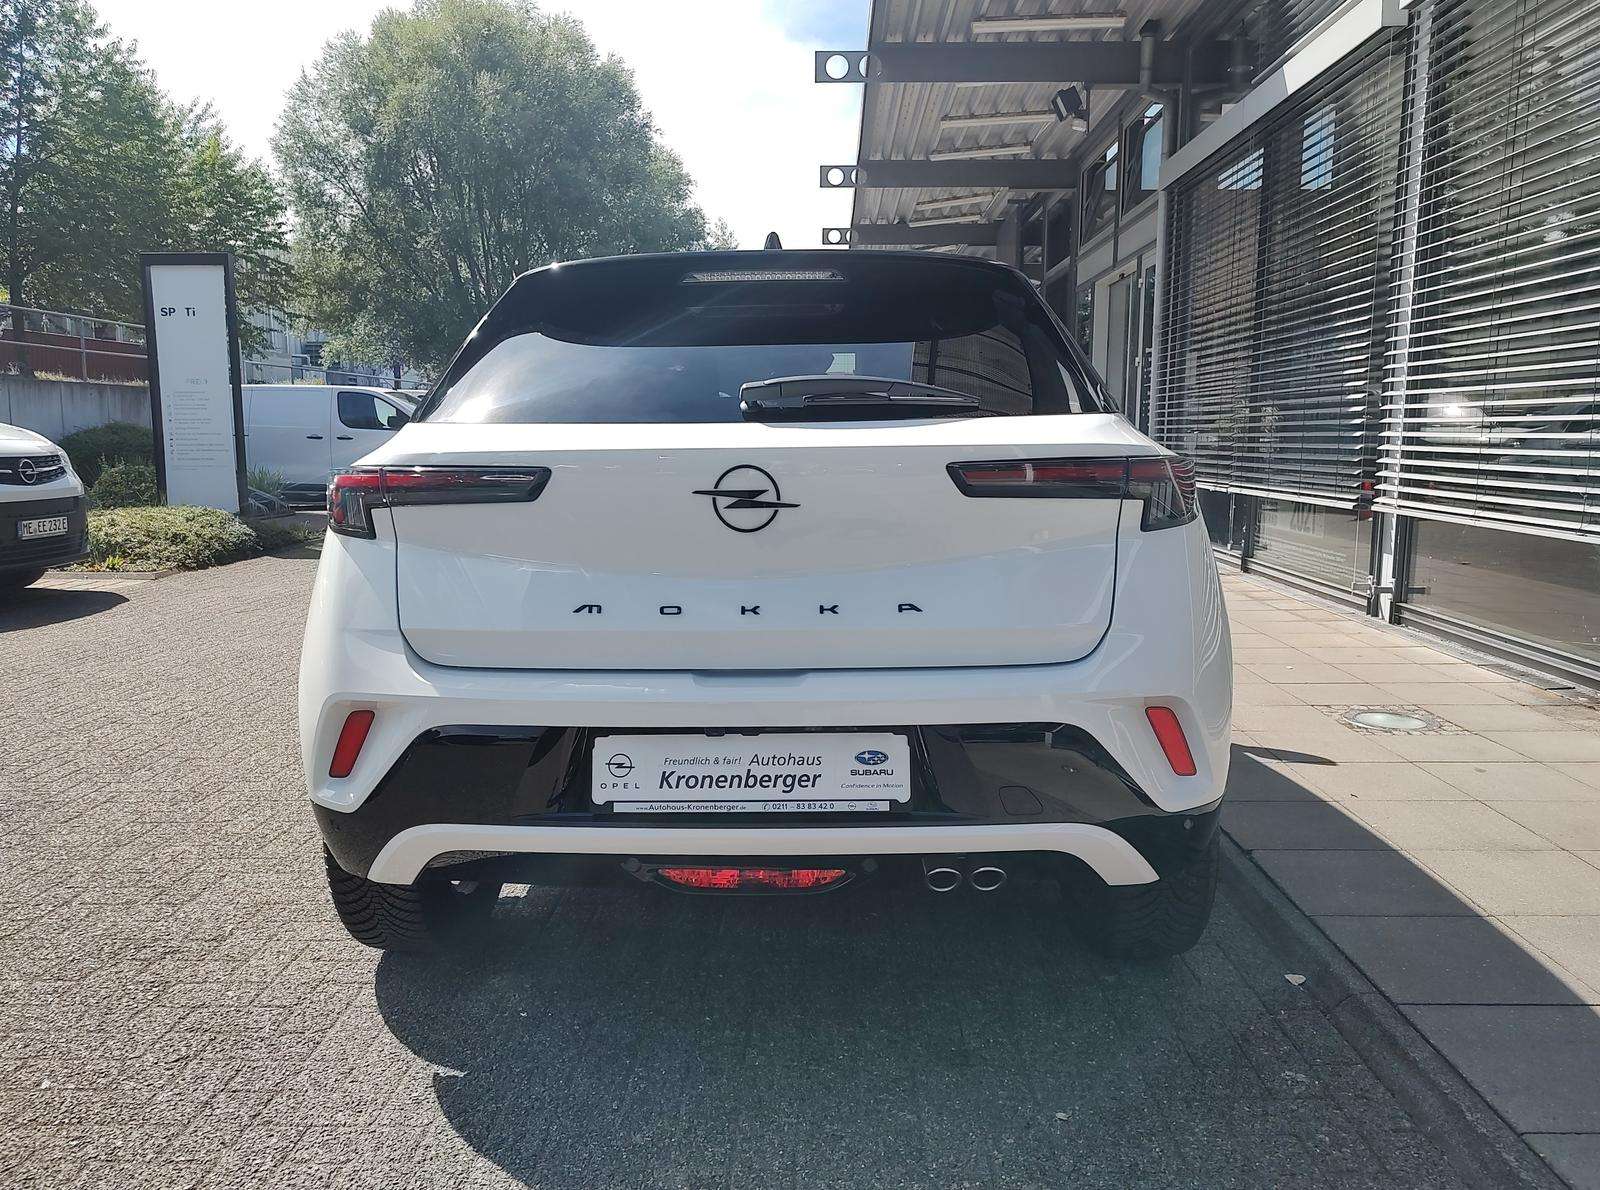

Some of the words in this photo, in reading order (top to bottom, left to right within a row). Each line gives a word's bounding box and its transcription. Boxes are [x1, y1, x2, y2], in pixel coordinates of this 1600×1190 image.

[160, 307, 176, 317] SP
[184, 307, 196, 317] Ti
[22, 522, 34, 535] ME
[573, 603, 923, 615] MOKKA
[663, 756, 710, 766] Freundlich
[712, 756, 720, 765] &
[722, 756, 742, 766] fair!
[748, 752, 822, 767] Autohaus
[600, 782, 640, 790] OPEL
[658, 768, 822, 793] Kronenberger
[771, 802, 788, 810] 0211
[796, 802, 806, 810] 83
[807, 802, 817, 810] 83
[818, 802, 828, 810] 42
